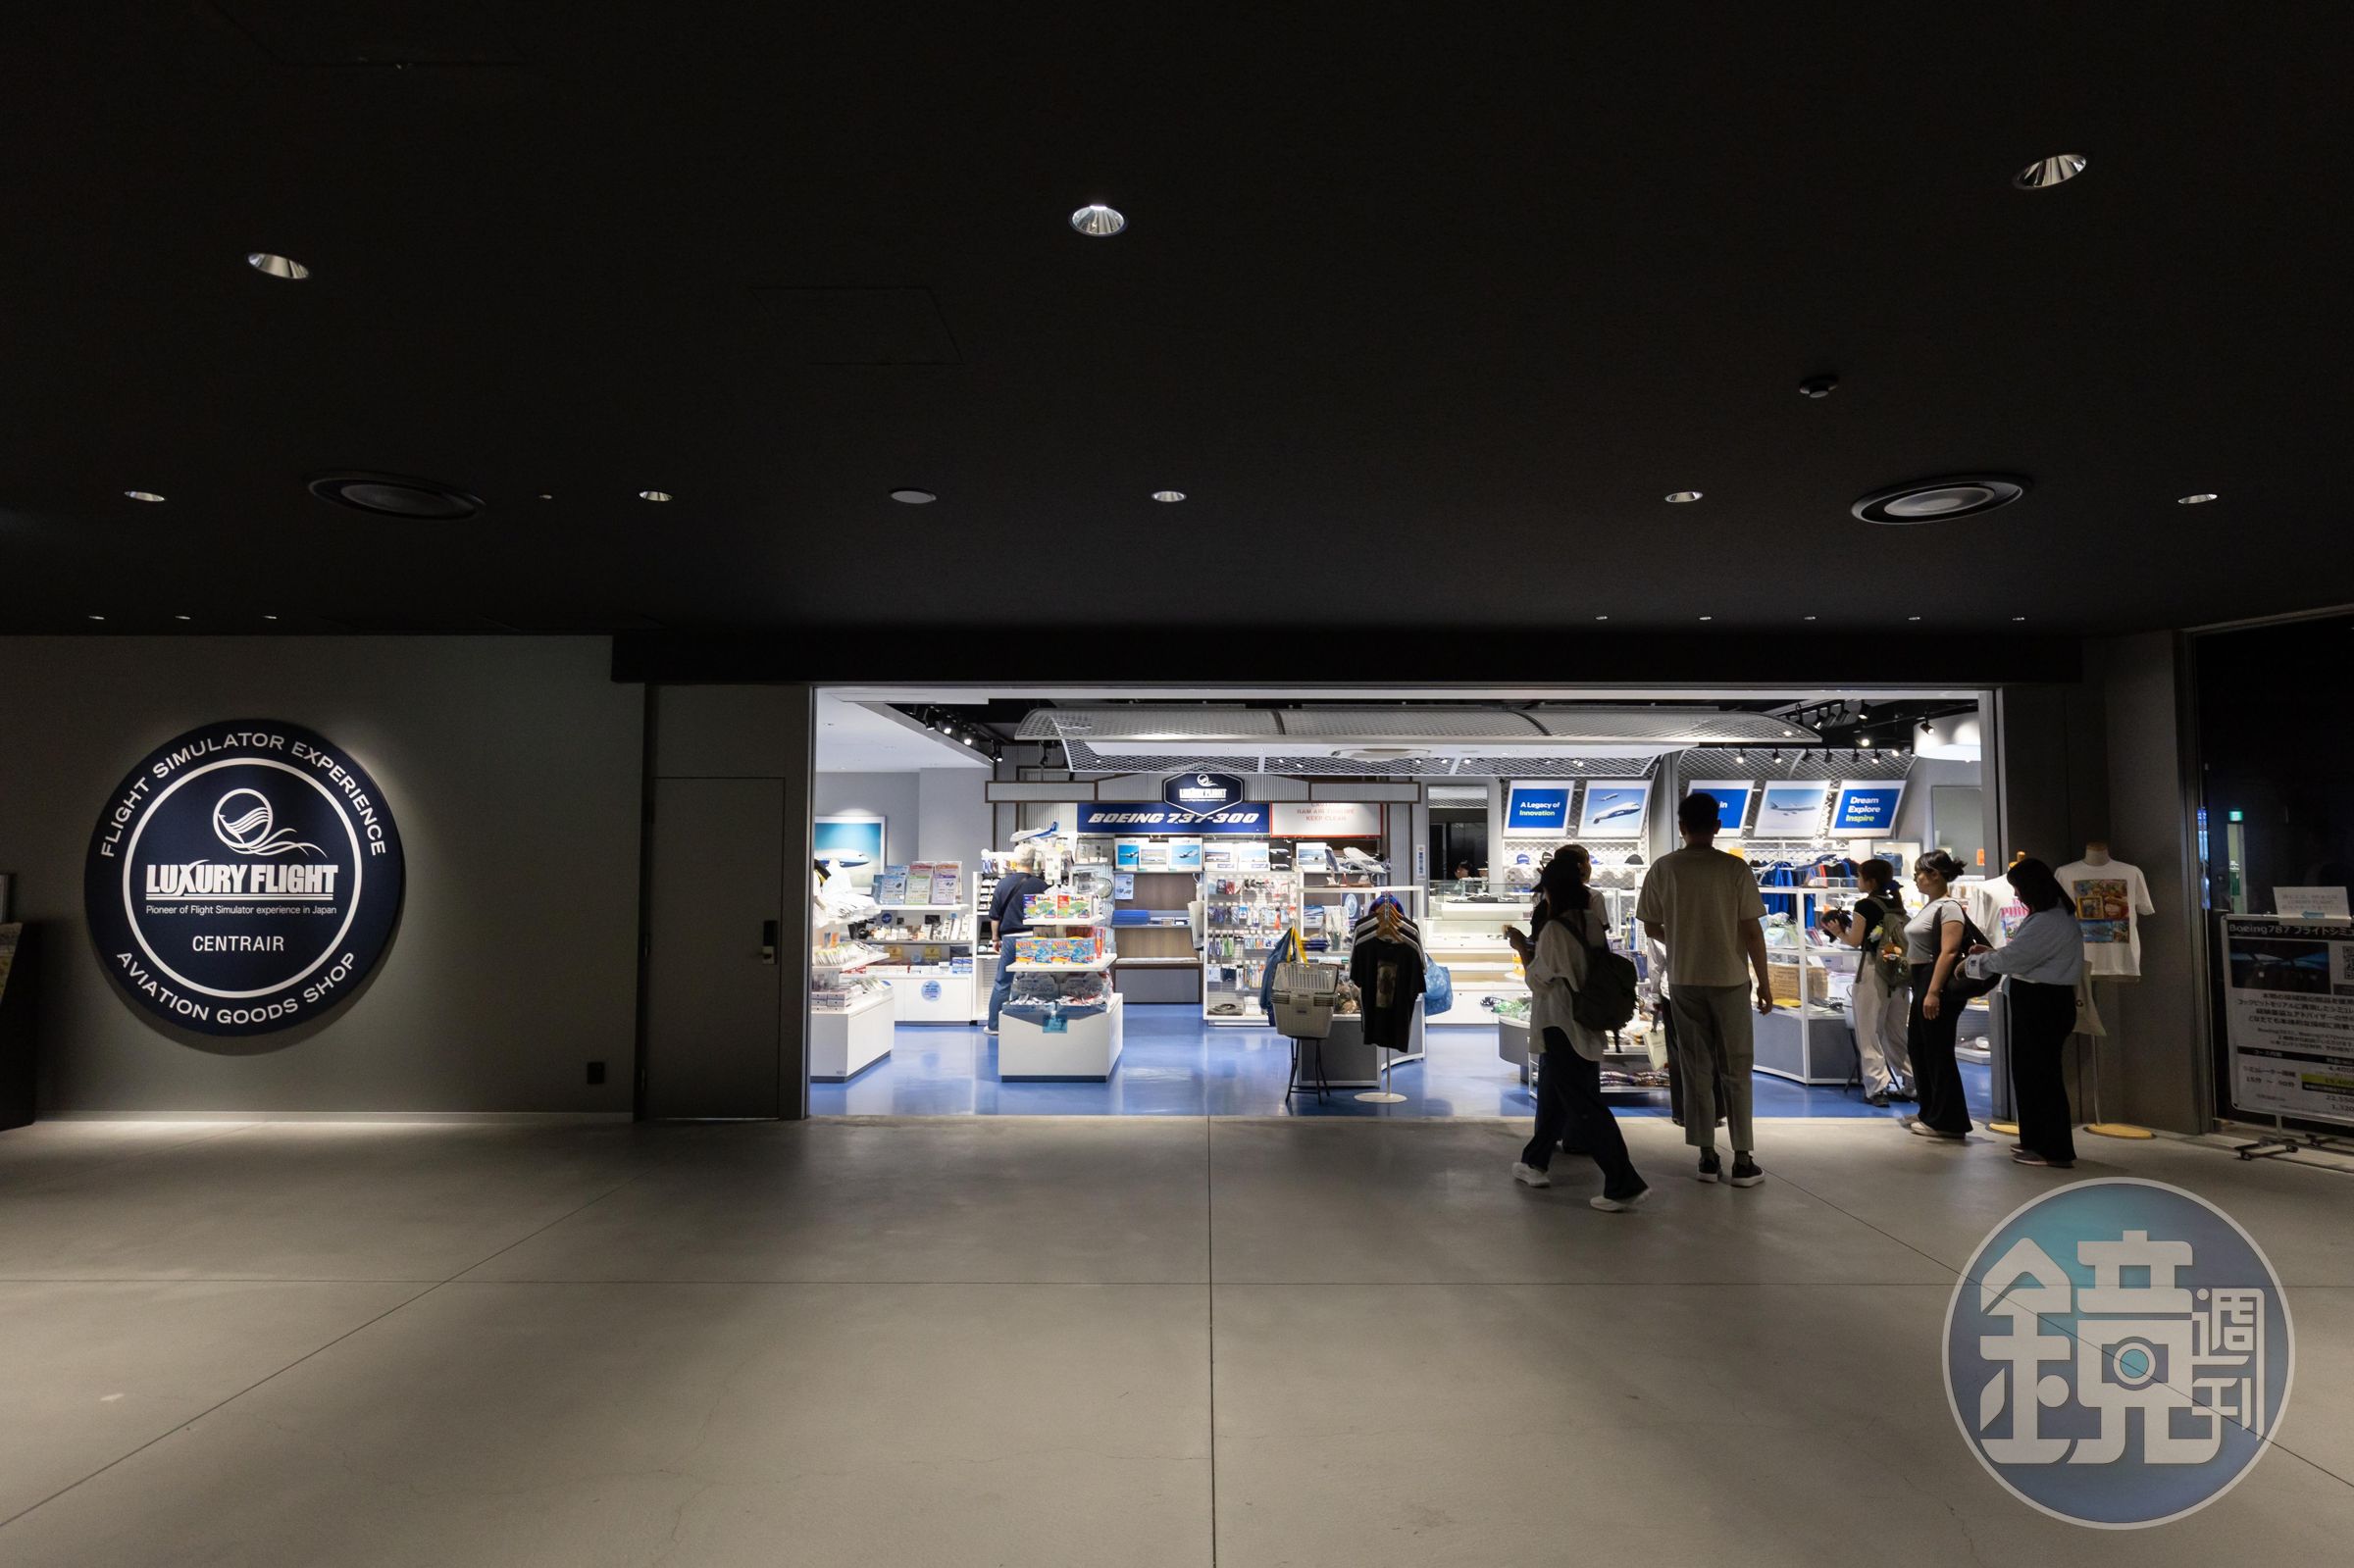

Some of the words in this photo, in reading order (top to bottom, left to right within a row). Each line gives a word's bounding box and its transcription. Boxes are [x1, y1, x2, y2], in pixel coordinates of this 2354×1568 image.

[101, 777, 150, 858] FLIGHT
[153, 732, 285, 779] SIMULATOR
[292, 741, 386, 856] EXPERIENCE
[1527, 801, 1552, 810] Legacy
[1848, 805, 1880, 814] Explore
[1088, 812, 1165, 824] BOEING
[146, 860, 248, 896] LUXURY
[251, 864, 338, 893] FLIGHT
[145, 905, 178, 914] Pioneer
[179, 905, 188, 914] of
[190, 904, 213, 915] Flight
[215, 905, 254, 914] Simulator
[256, 905, 301, 916] experience
[302, 905, 310, 914] in
[311, 905, 337, 915] Japan
[191, 936, 284, 952] CENTRAIR
[117, 951, 210, 1021] AVIATION
[216, 997, 298, 1025] GOODS
[305, 952, 355, 1003] SHOP
